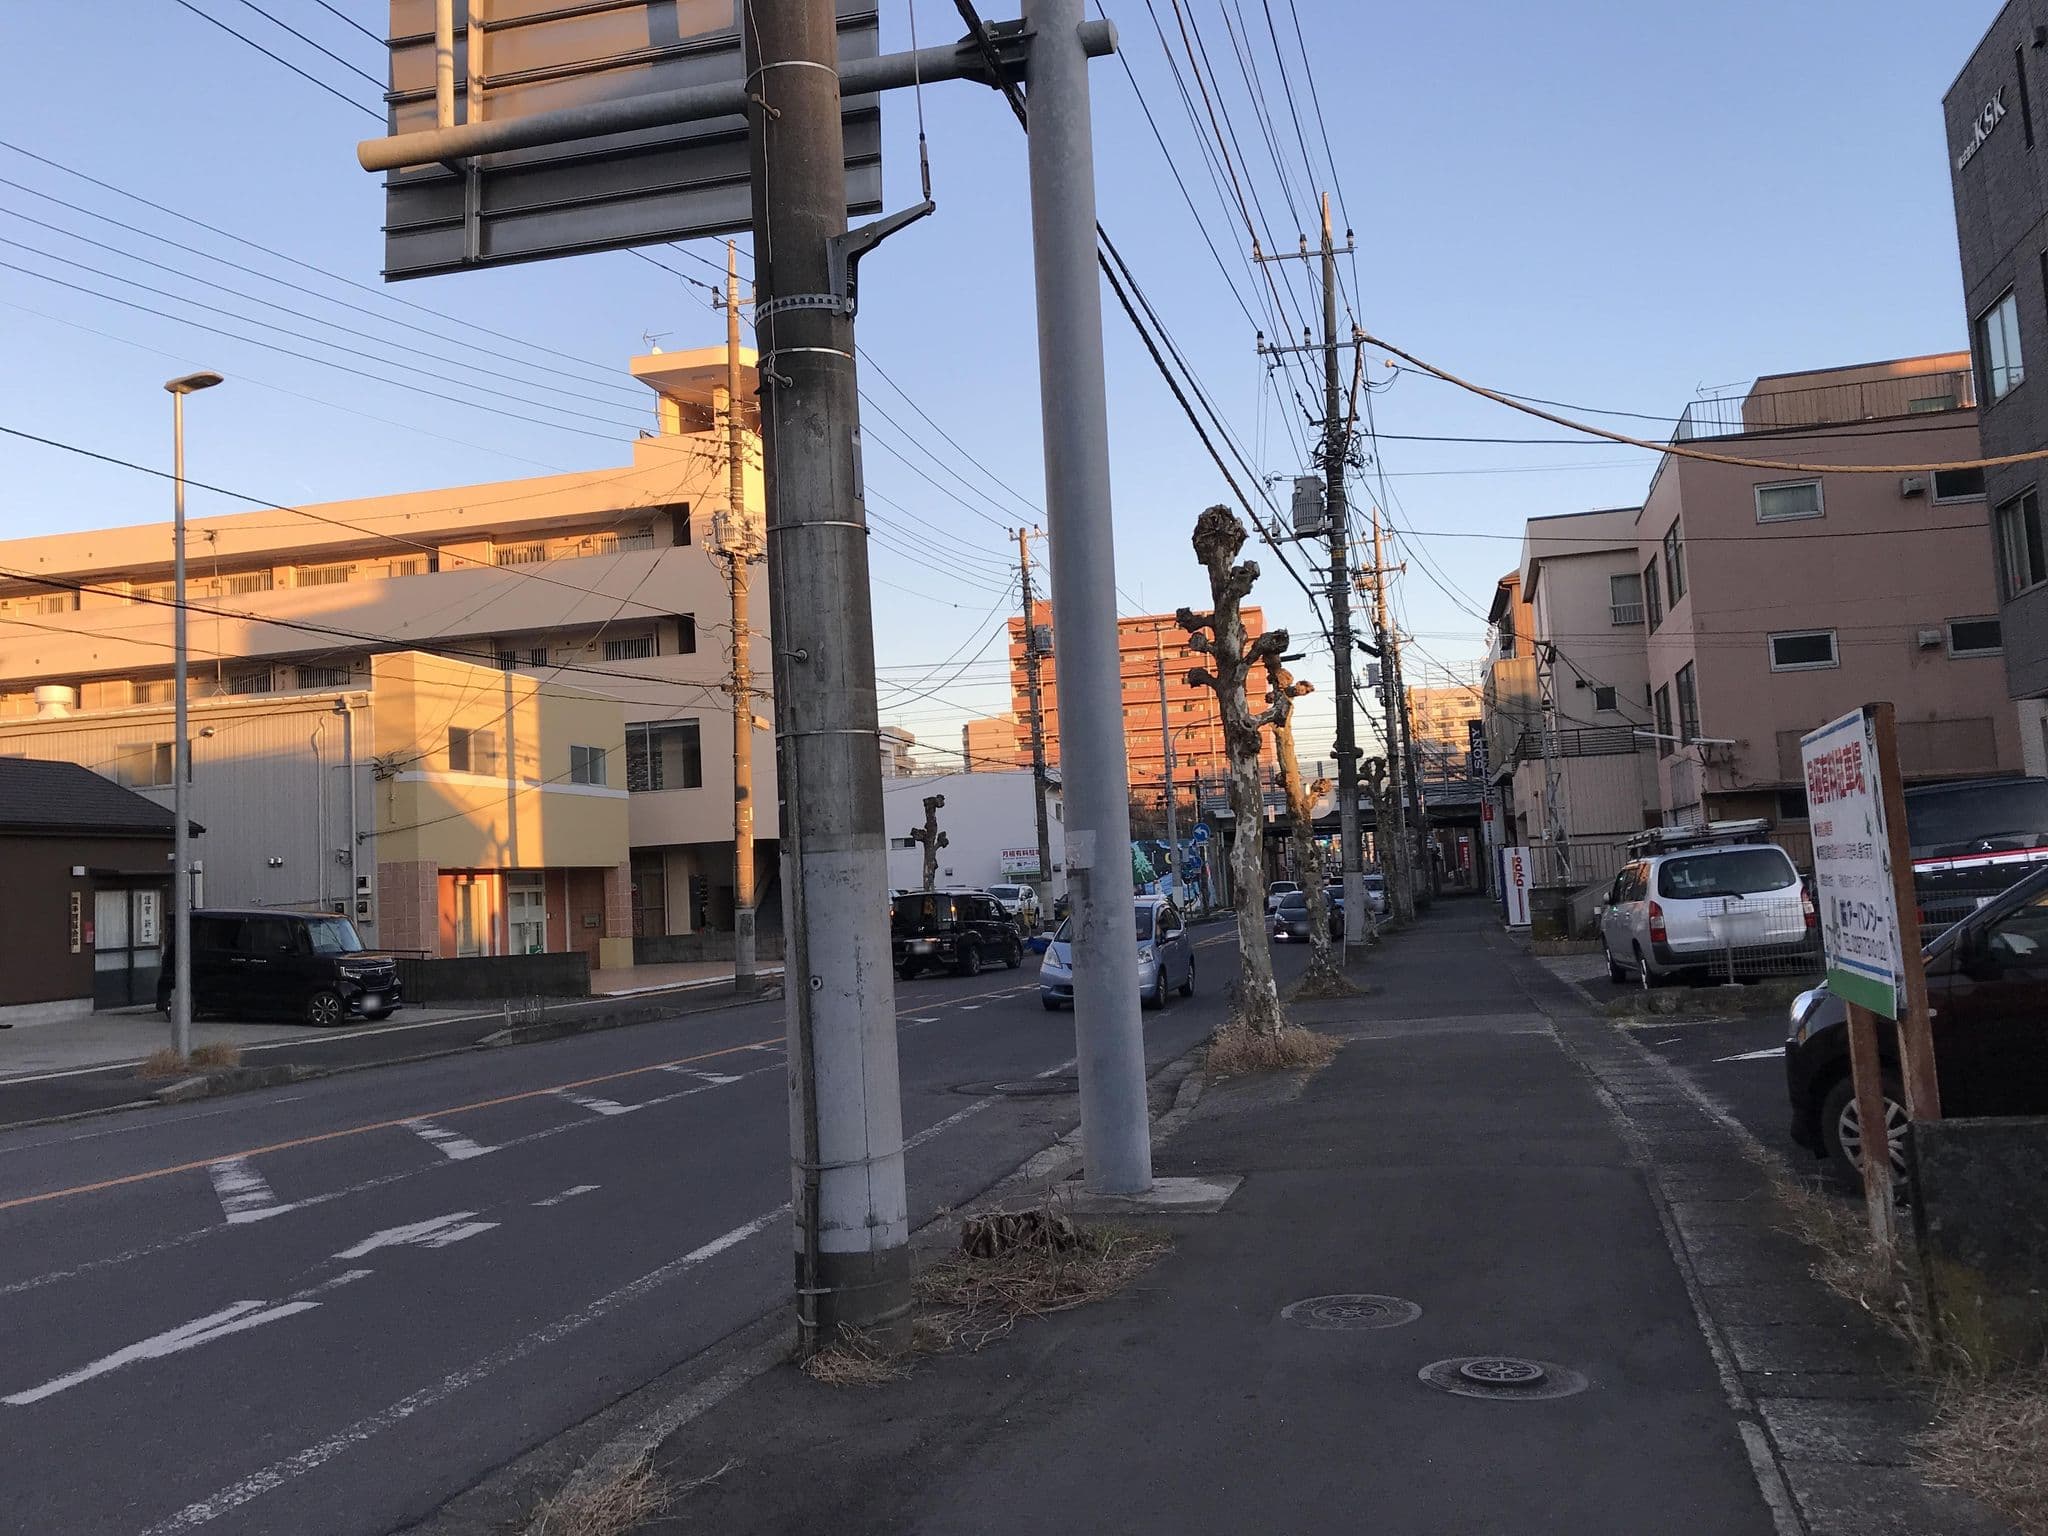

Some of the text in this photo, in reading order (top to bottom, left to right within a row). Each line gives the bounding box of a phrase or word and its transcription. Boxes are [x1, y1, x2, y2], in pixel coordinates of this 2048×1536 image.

[1974, 85, 2006, 148] KSK
[1472, 728, 1482, 769] SONY
[1515, 856, 1525, 887] DyDo
